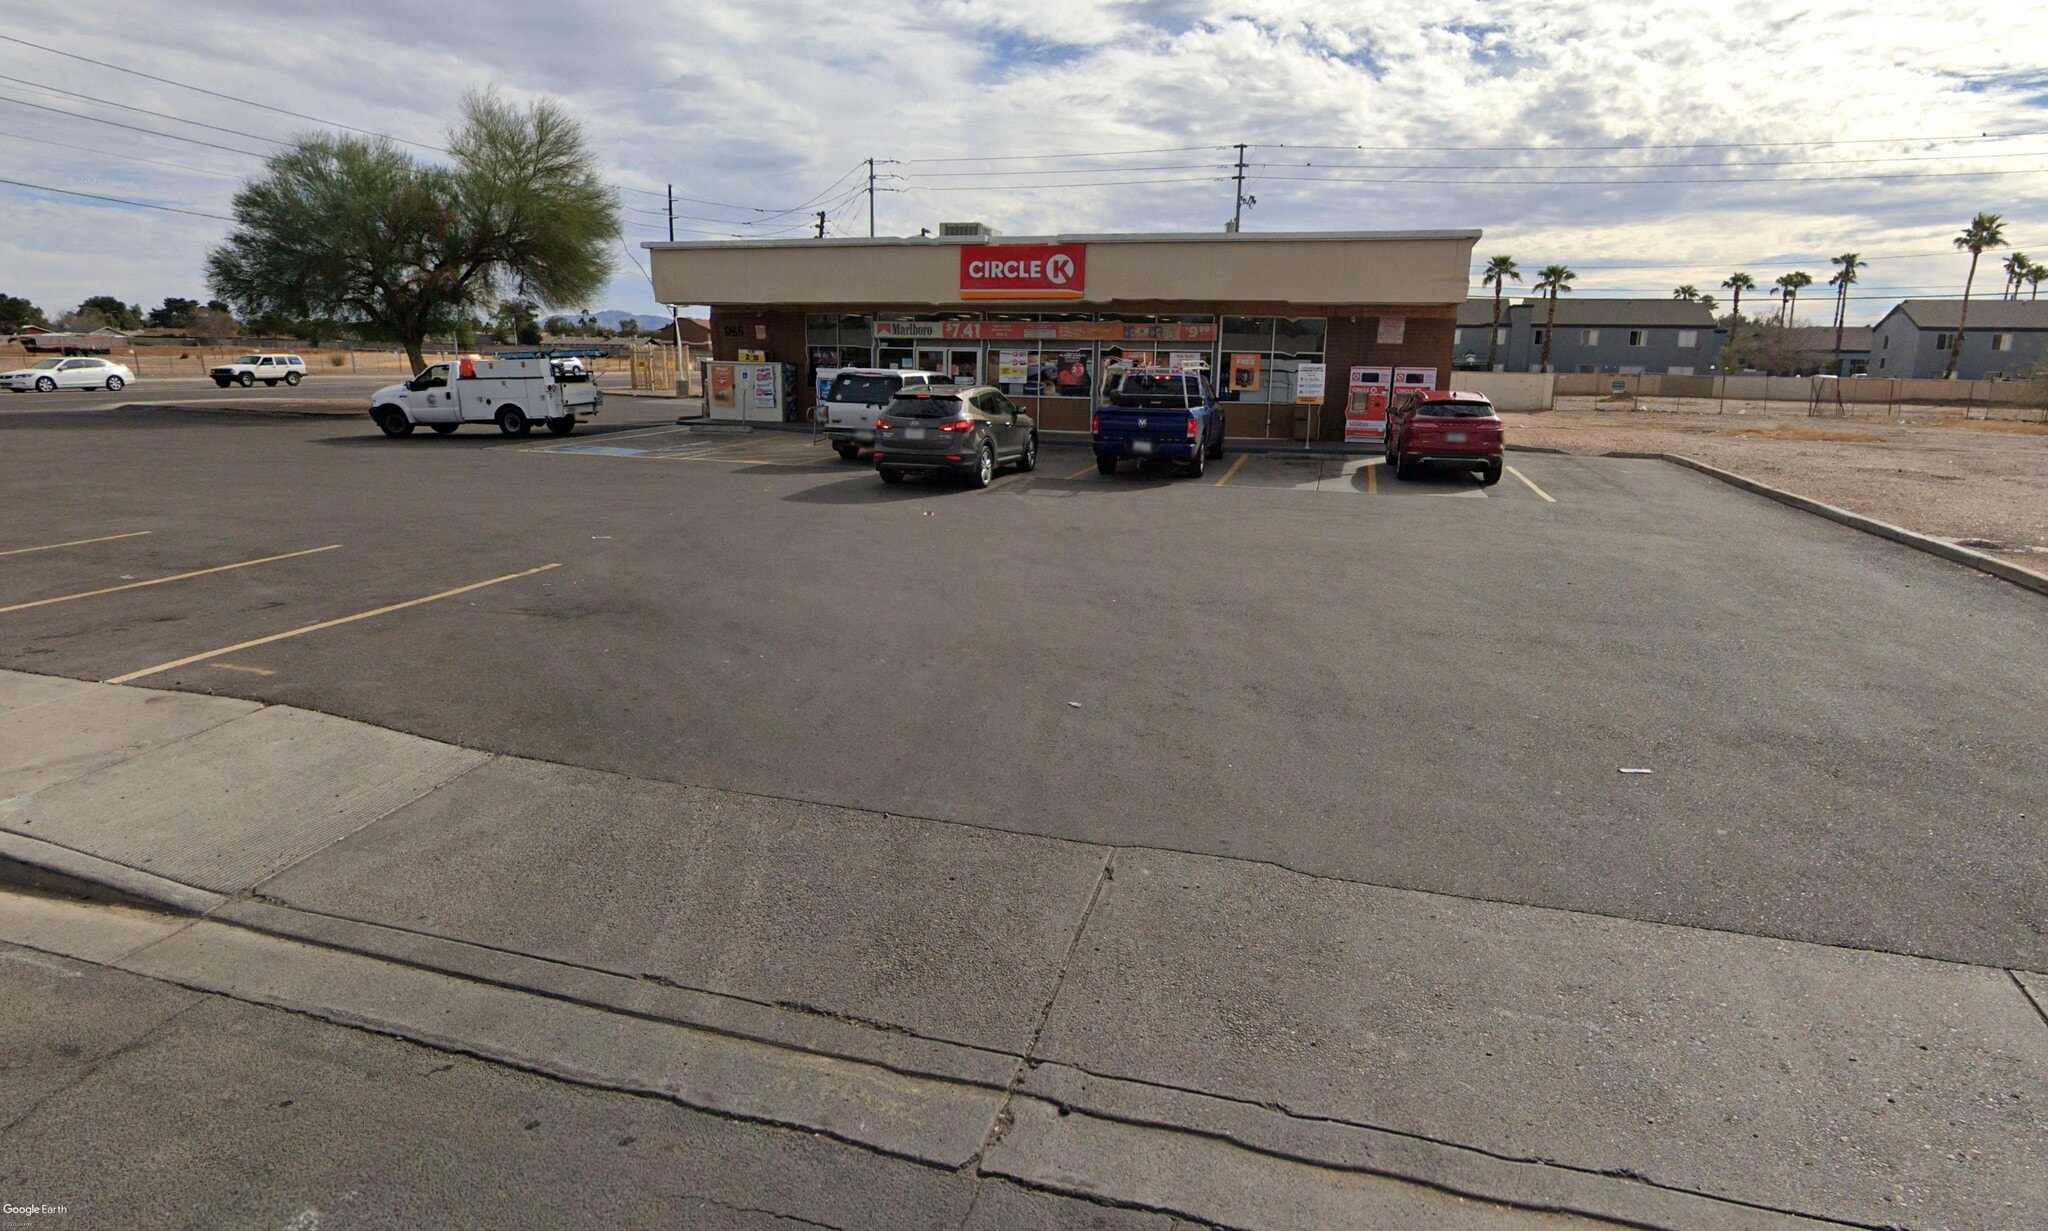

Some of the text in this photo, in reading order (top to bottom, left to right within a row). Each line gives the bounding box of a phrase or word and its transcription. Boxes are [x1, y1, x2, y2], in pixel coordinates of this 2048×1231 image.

[968, 257, 1073, 283] CIRCLE K
[724, 325, 744, 337] 955
[891, 323, 933, 336] Marlboro
